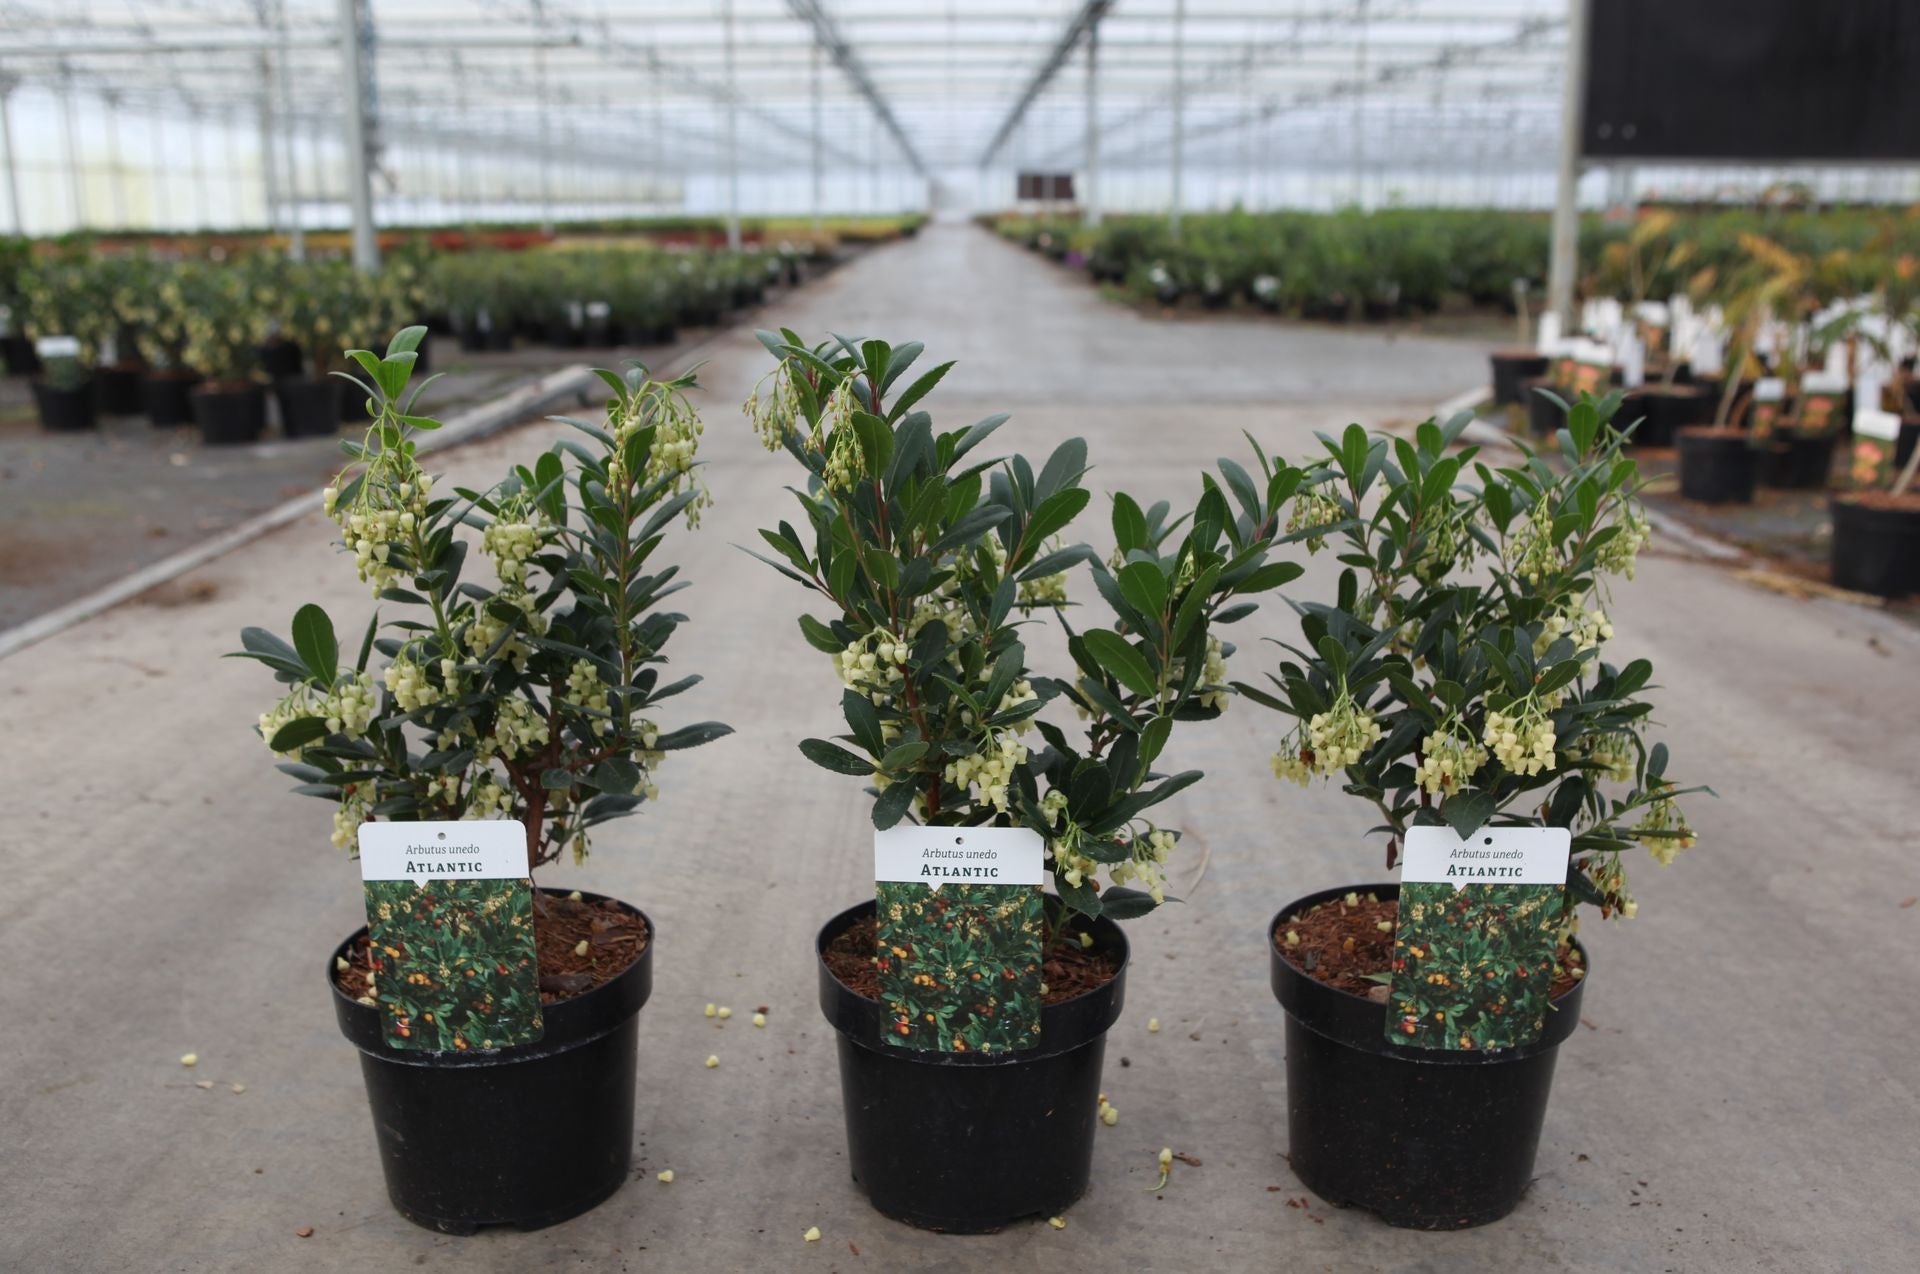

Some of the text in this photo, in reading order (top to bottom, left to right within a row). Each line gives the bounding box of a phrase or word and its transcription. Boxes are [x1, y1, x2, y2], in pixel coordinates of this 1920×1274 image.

[405, 844, 480, 855] Arbutus unedo
[922, 848, 998, 859] Arbutus unedo
[1449, 848, 1524, 859] Arbutus unedo
[406, 861, 483, 873] ATLANTIC
[921, 864, 998, 877] ATLANTIC
[1446, 864, 1523, 877] ATLANTIC
